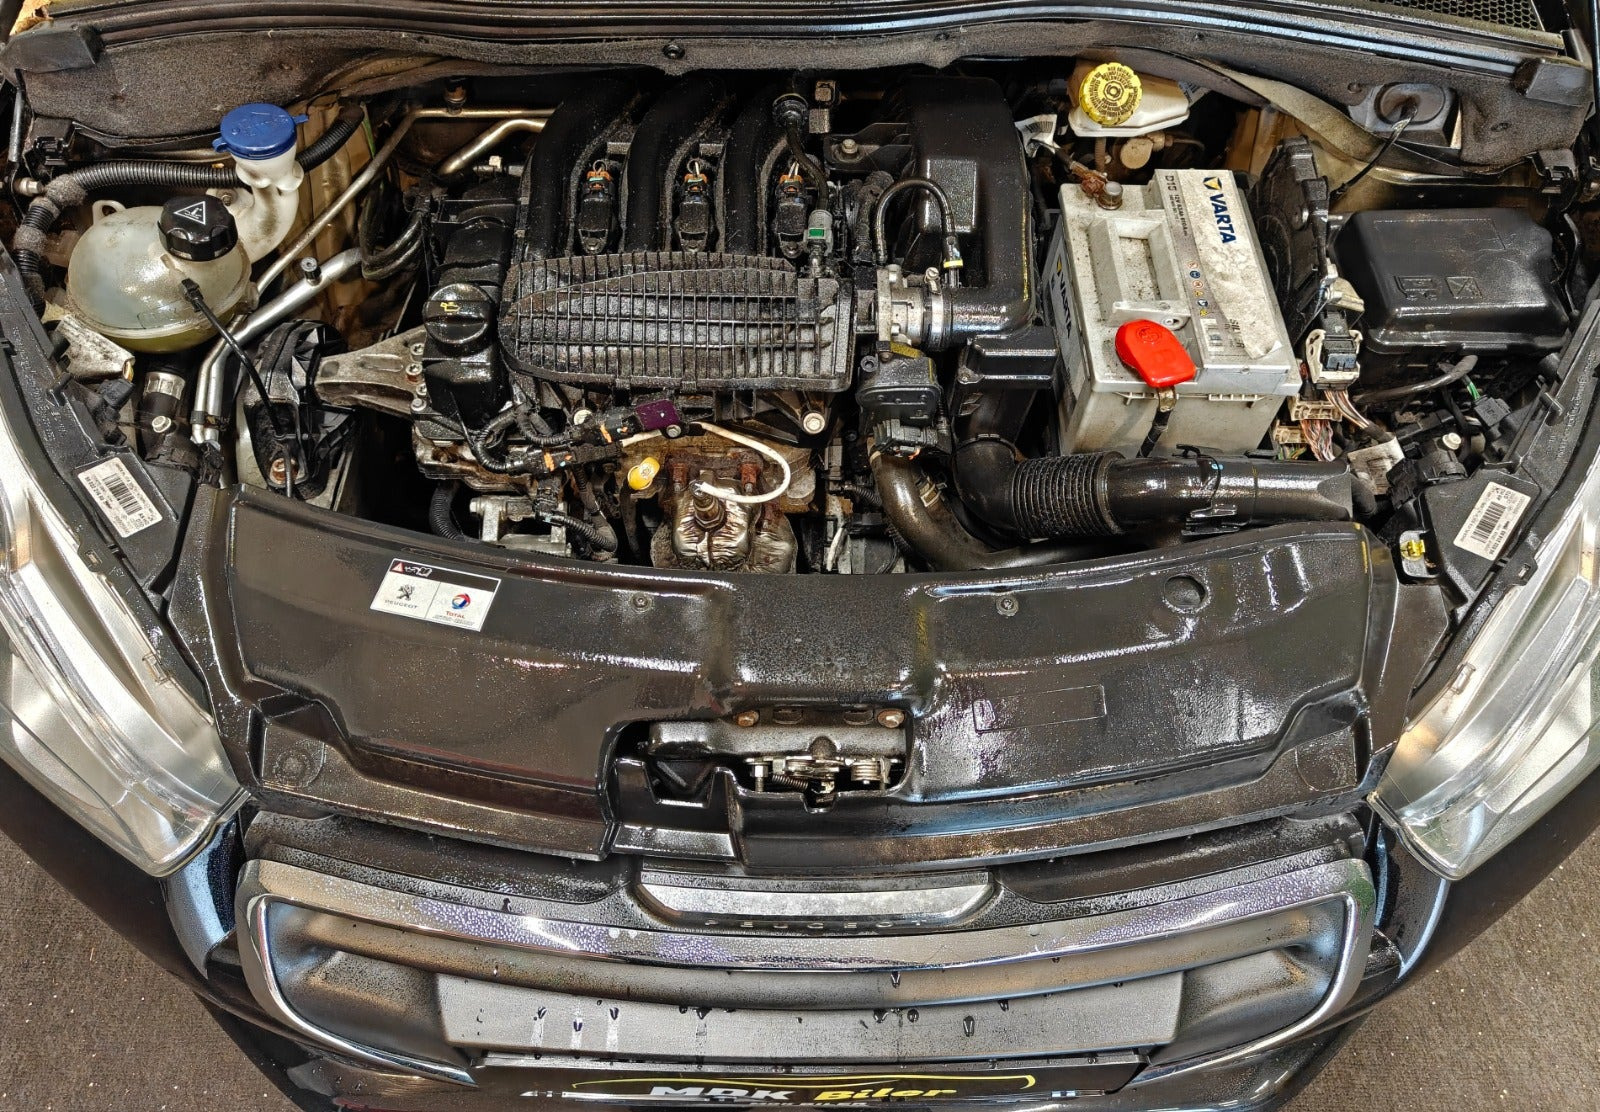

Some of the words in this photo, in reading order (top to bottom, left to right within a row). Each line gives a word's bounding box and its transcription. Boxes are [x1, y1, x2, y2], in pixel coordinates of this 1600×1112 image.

[1165, 175, 1177, 191] D15
[1209, 193, 1236, 244] VARTA
[1060, 272, 1072, 339] VARTA
[384, 599, 418, 609] PEUGEOT
[445, 610, 465, 619] TOTAL
[814, 1088, 957, 1100] Biler
